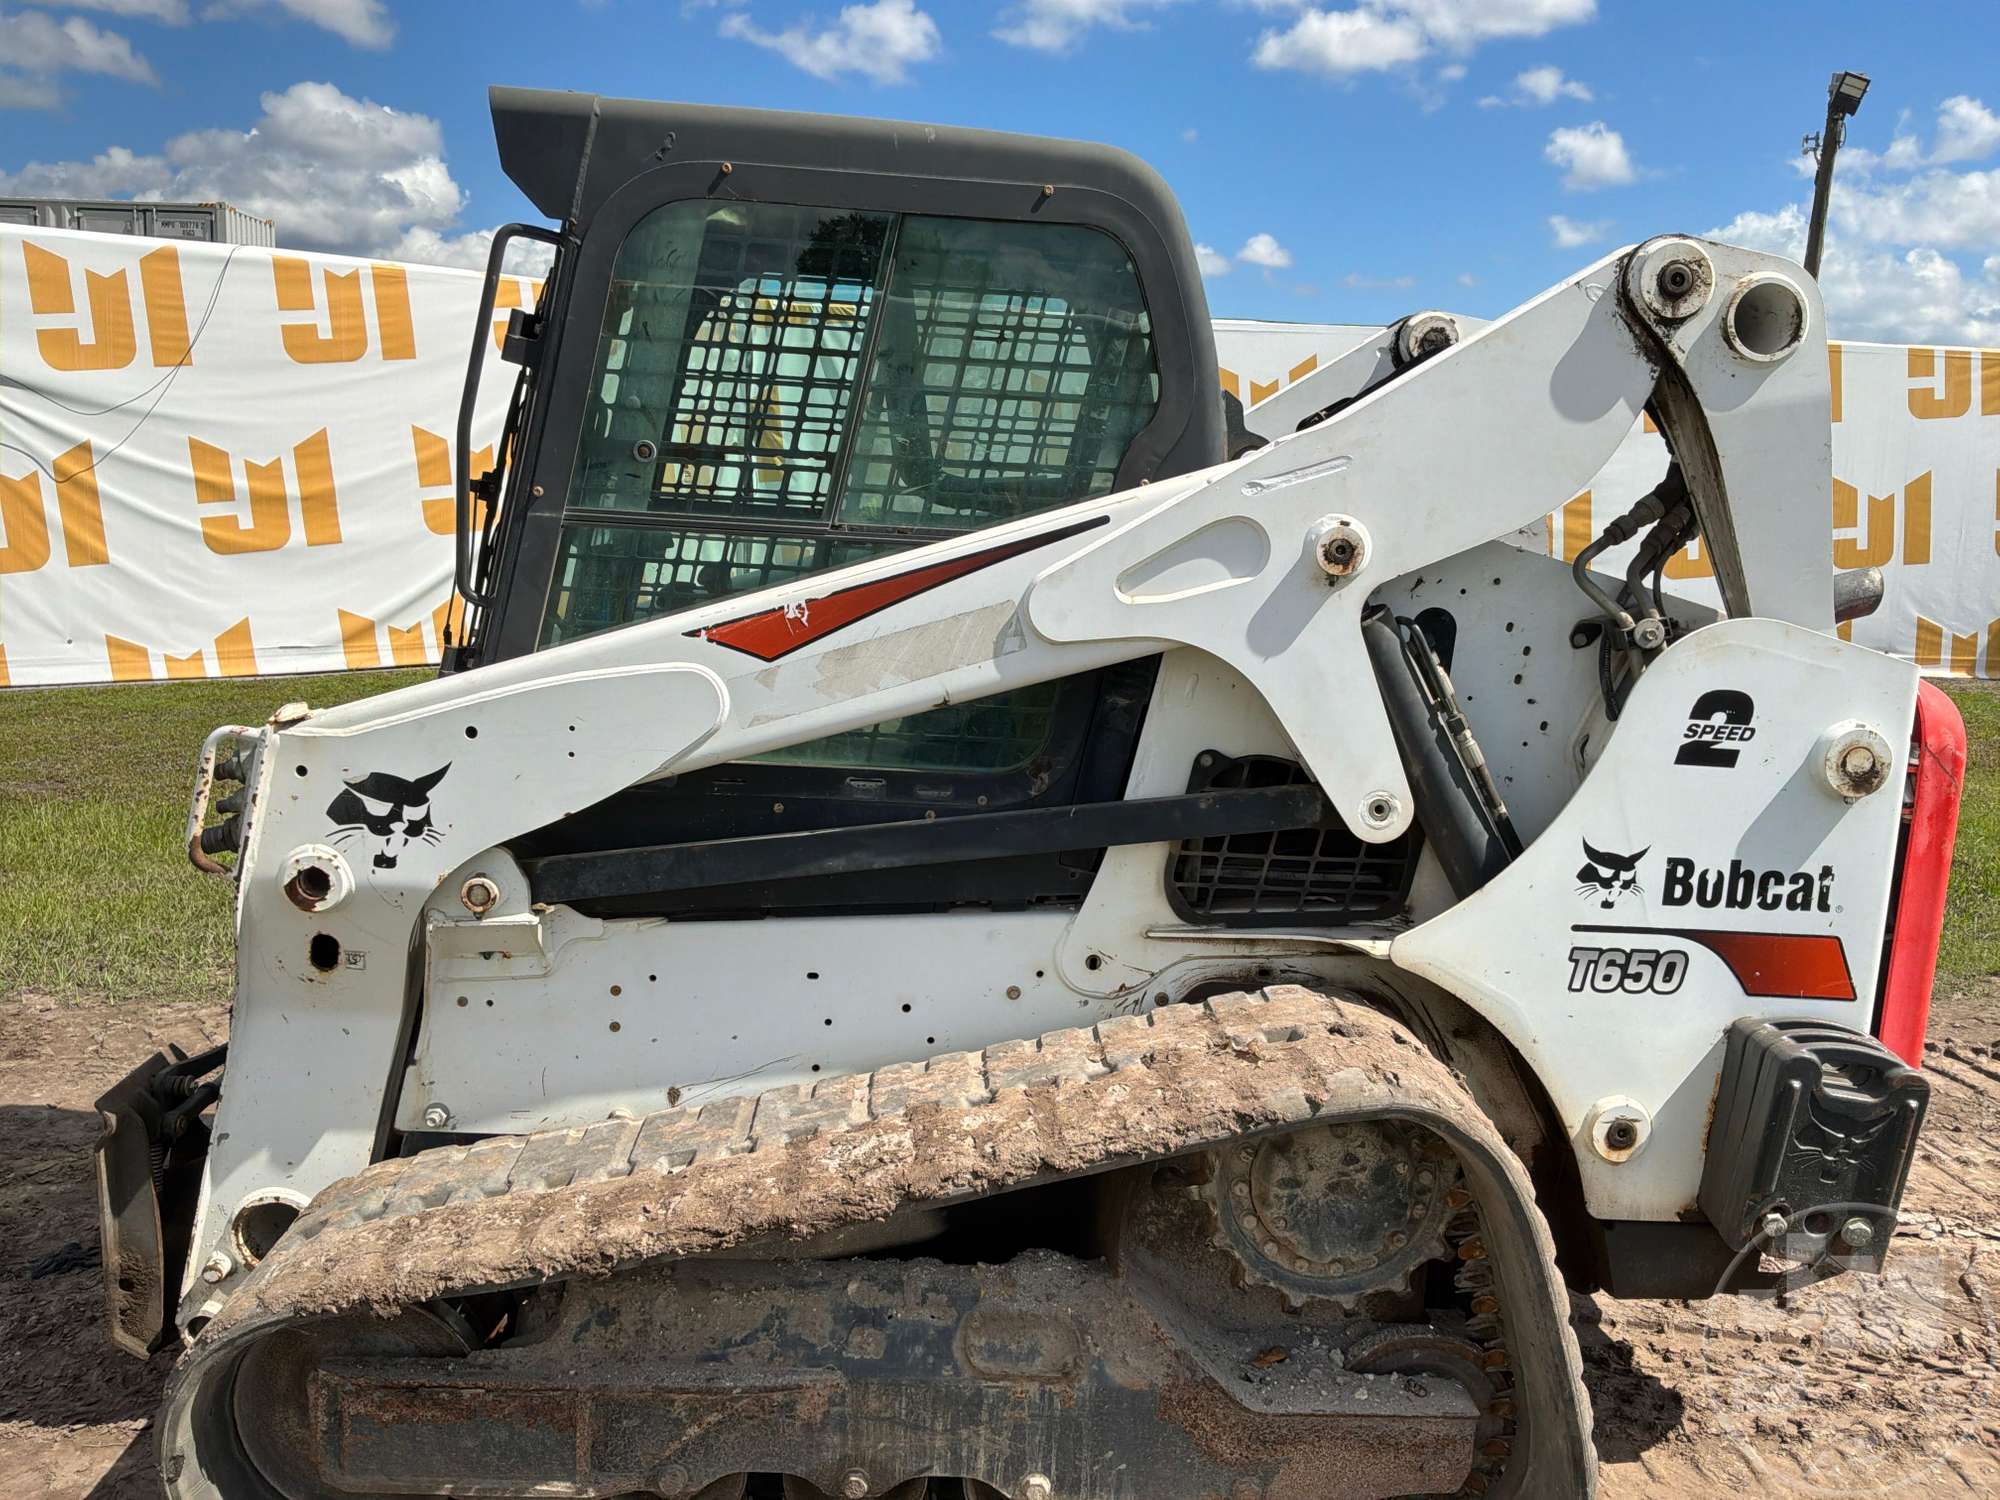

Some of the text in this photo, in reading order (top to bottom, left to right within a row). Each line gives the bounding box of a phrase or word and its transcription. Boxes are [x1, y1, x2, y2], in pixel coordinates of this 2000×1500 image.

[1674, 689, 1755, 768] 2
[1683, 723, 1756, 742] SPEED
[1662, 856, 1836, 913] Bobcat
[1568, 946, 1690, 995] T650
